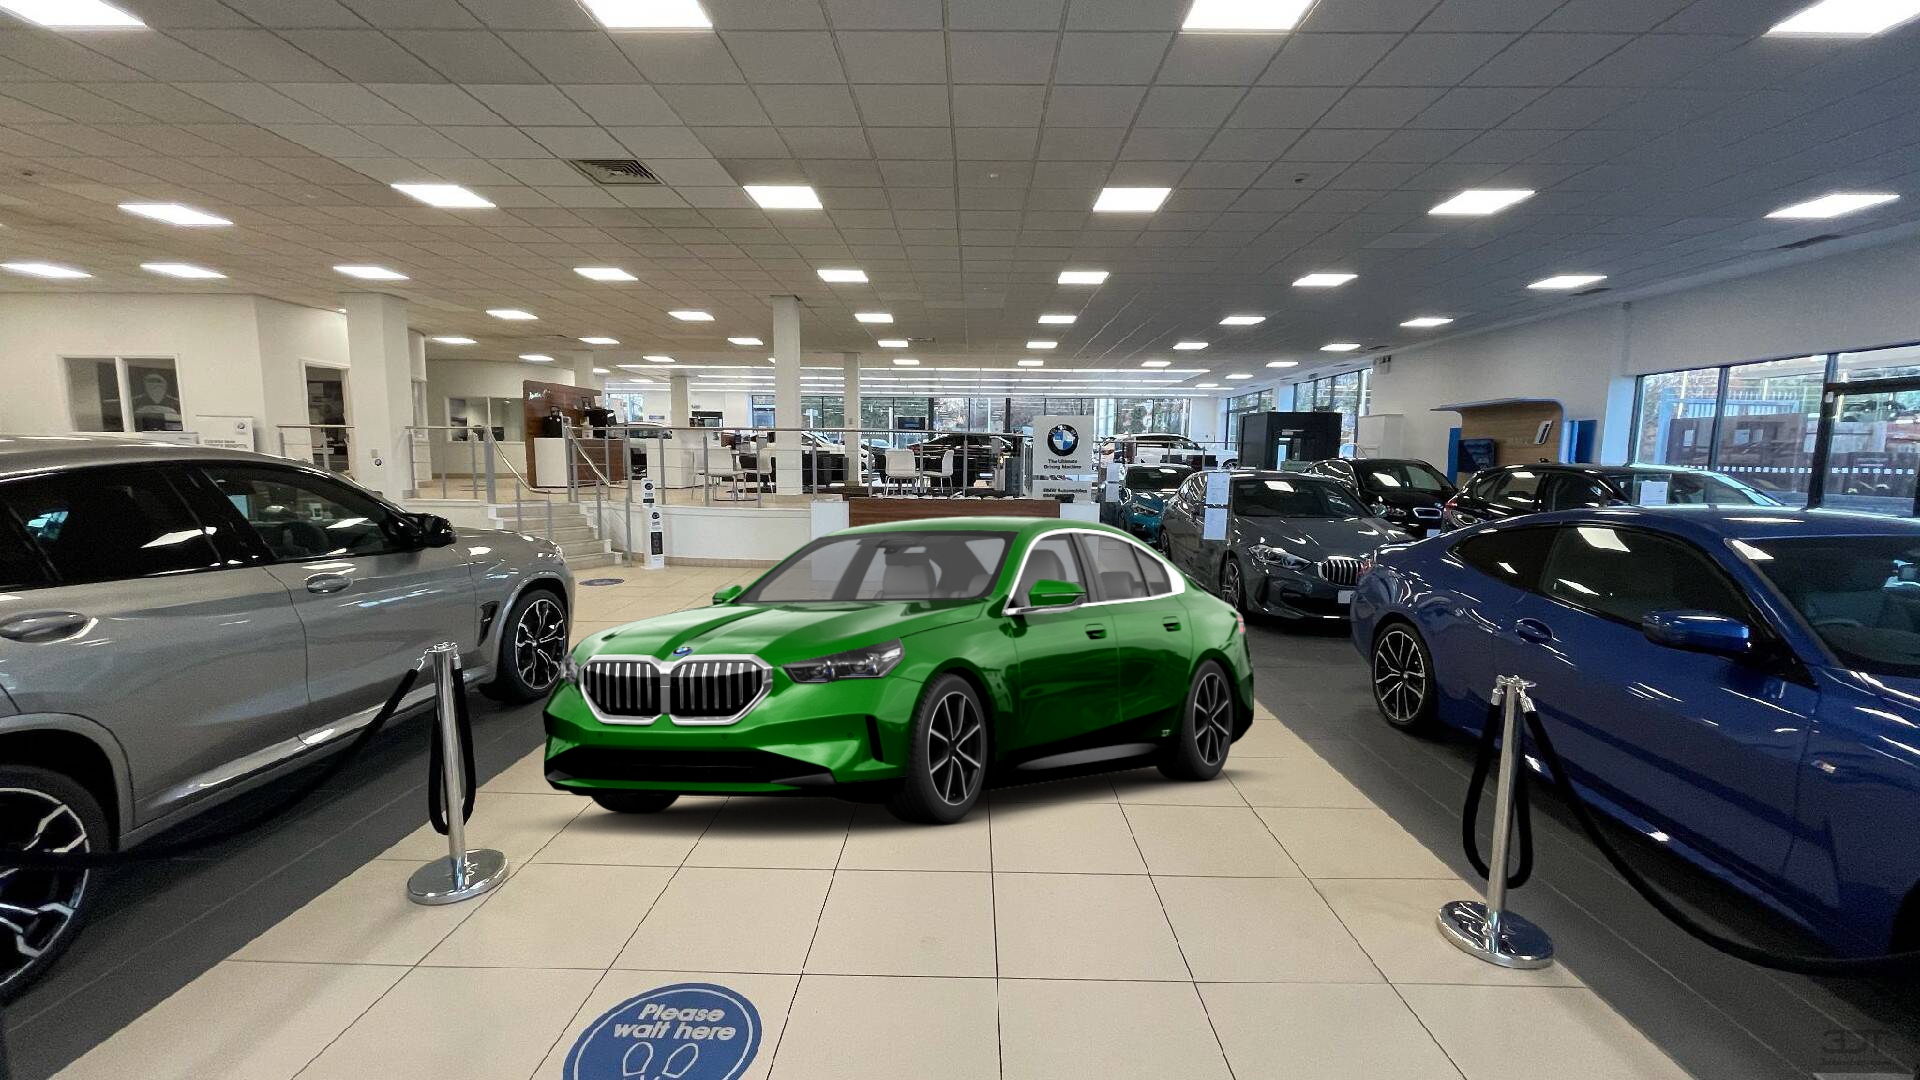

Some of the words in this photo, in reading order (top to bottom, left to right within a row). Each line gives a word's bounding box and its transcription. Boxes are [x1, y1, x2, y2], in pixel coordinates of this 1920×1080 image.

[639, 1003, 726, 1022] Please
[613, 1022, 672, 1039] wait
[673, 1023, 737, 1041] here
